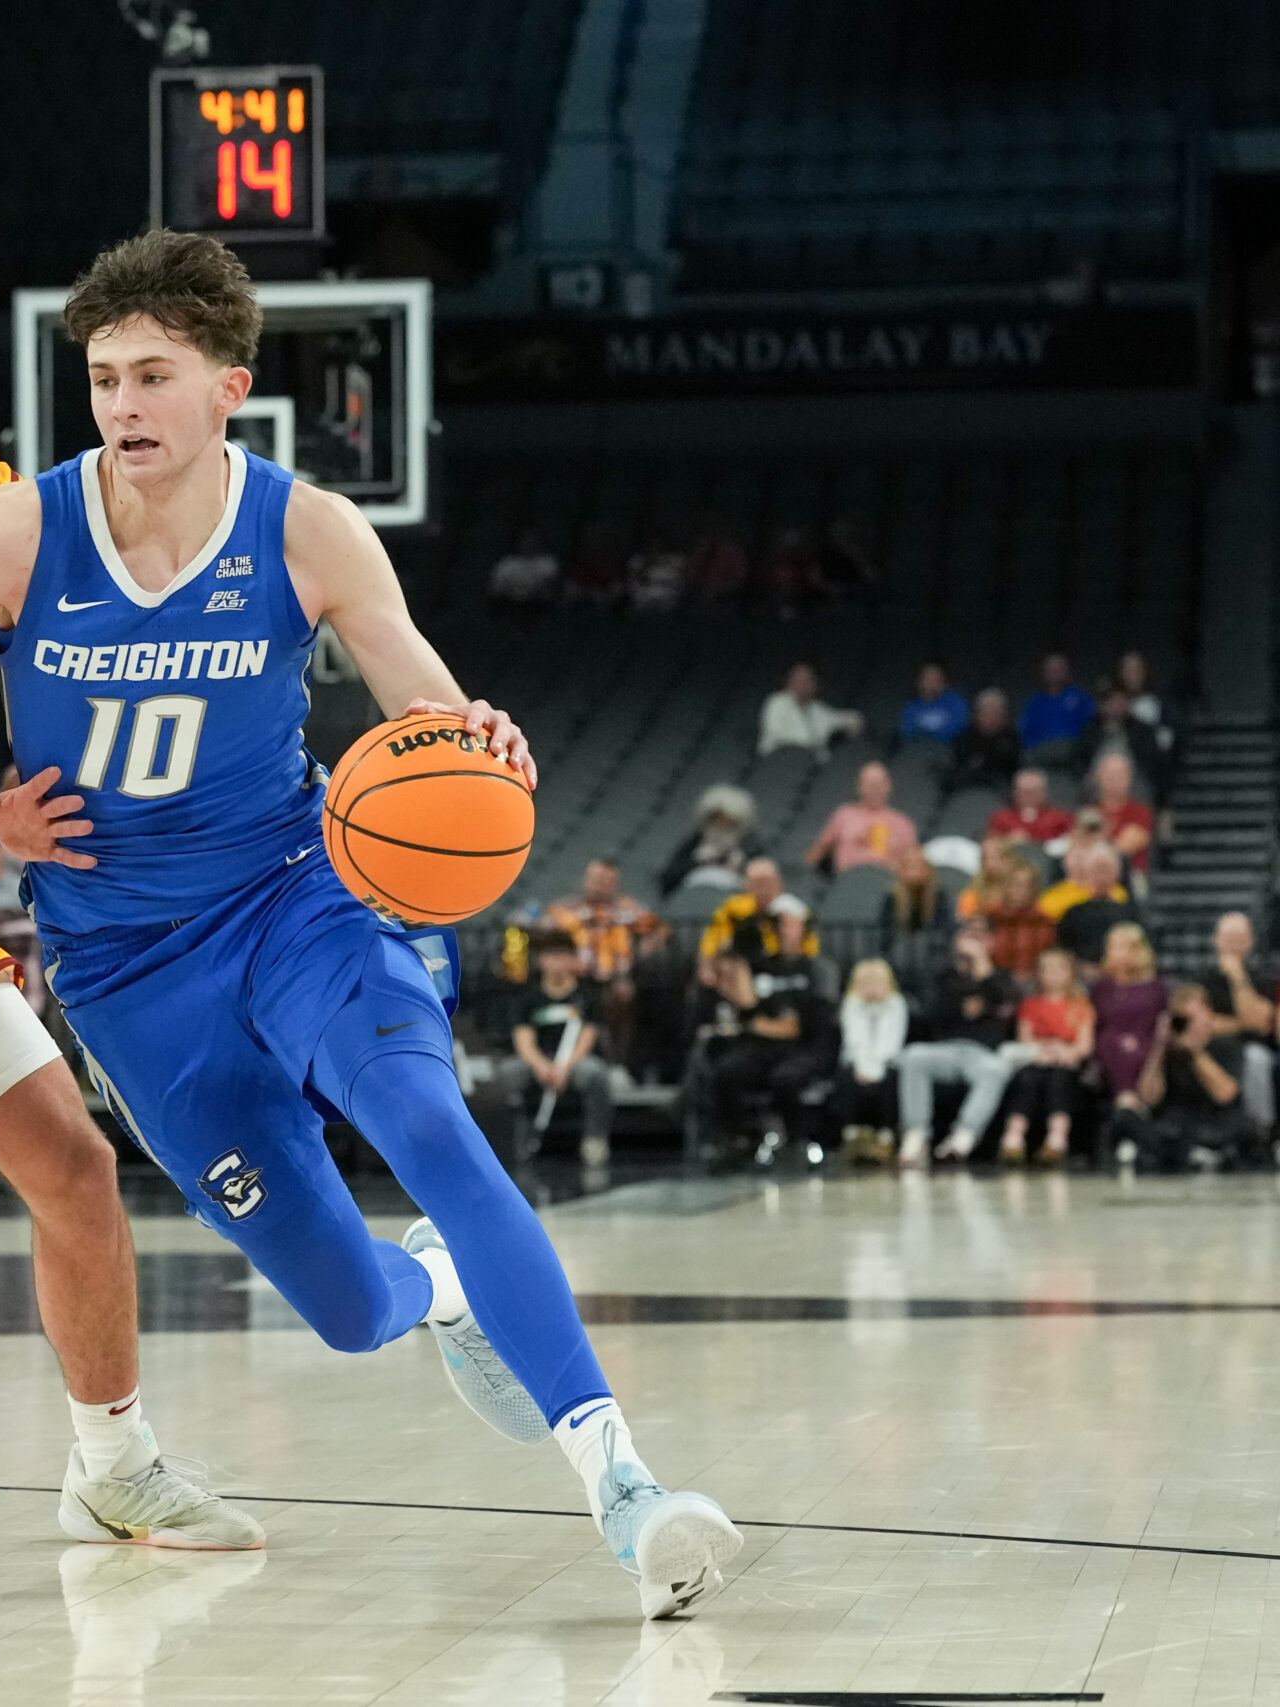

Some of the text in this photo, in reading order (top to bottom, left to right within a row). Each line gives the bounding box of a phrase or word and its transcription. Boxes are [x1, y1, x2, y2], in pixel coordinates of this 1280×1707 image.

[200, 88, 305, 135] 4:41
[218, 139, 292, 220] 14
[606, 322, 1054, 375] MANDALAY BAY
[215, 564, 254, 579] CHANGE
[219, 555, 252, 569] BE THE
[205, 598, 249, 609] EAST
[210, 590, 241, 601] BIG
[33, 639, 270, 682] CREIGHTON
[74, 694, 209, 800] 10
